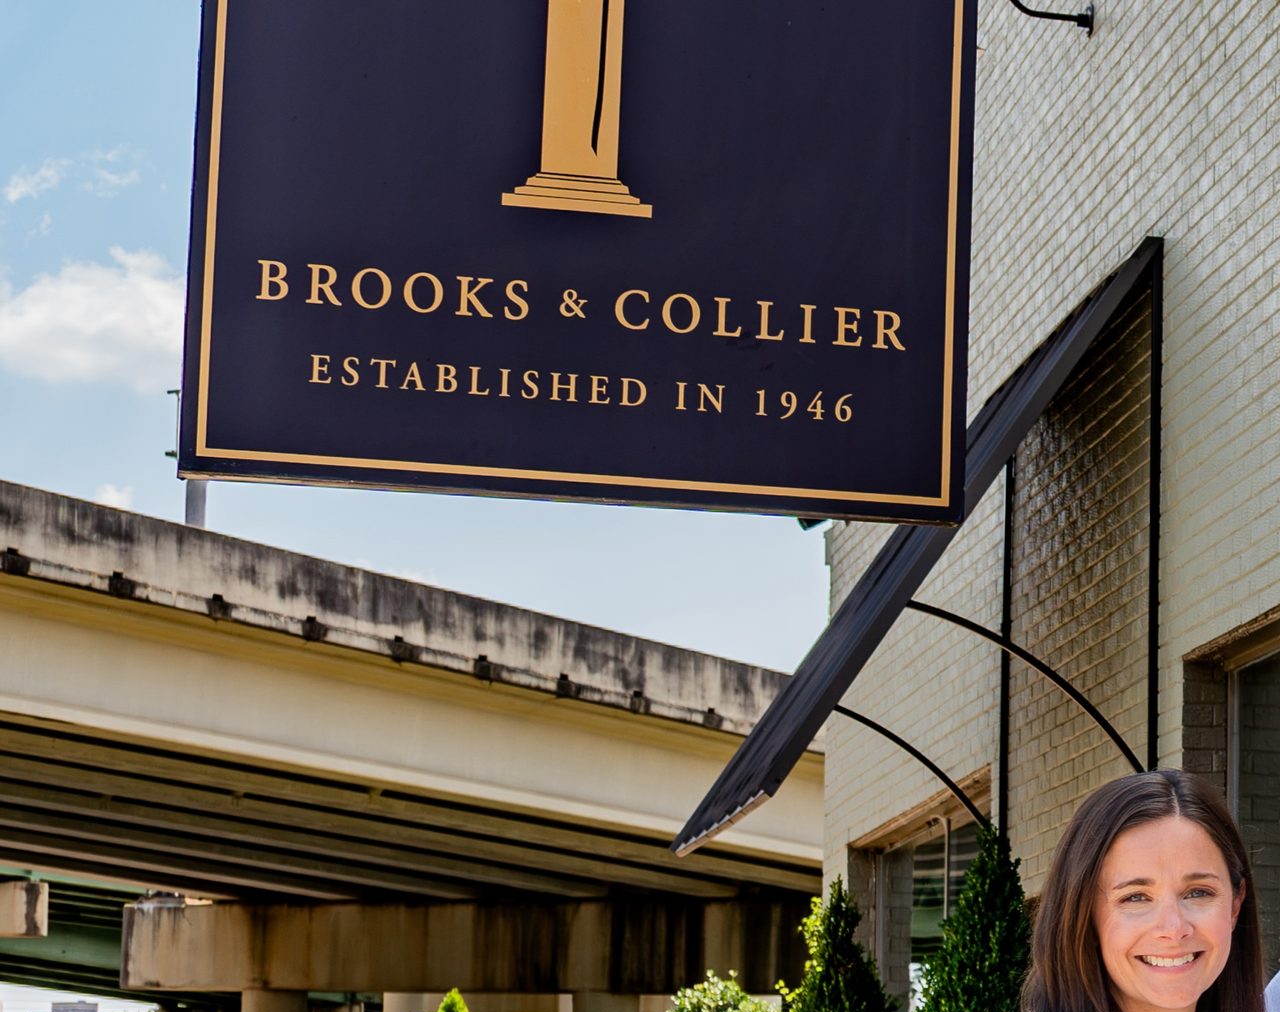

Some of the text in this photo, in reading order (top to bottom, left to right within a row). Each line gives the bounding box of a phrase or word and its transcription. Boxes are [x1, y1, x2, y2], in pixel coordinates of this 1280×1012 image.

[255, 259, 906, 352] BROOKS & COLLIER
[308, 353, 854, 423] ESTABLISHED IN 1946
